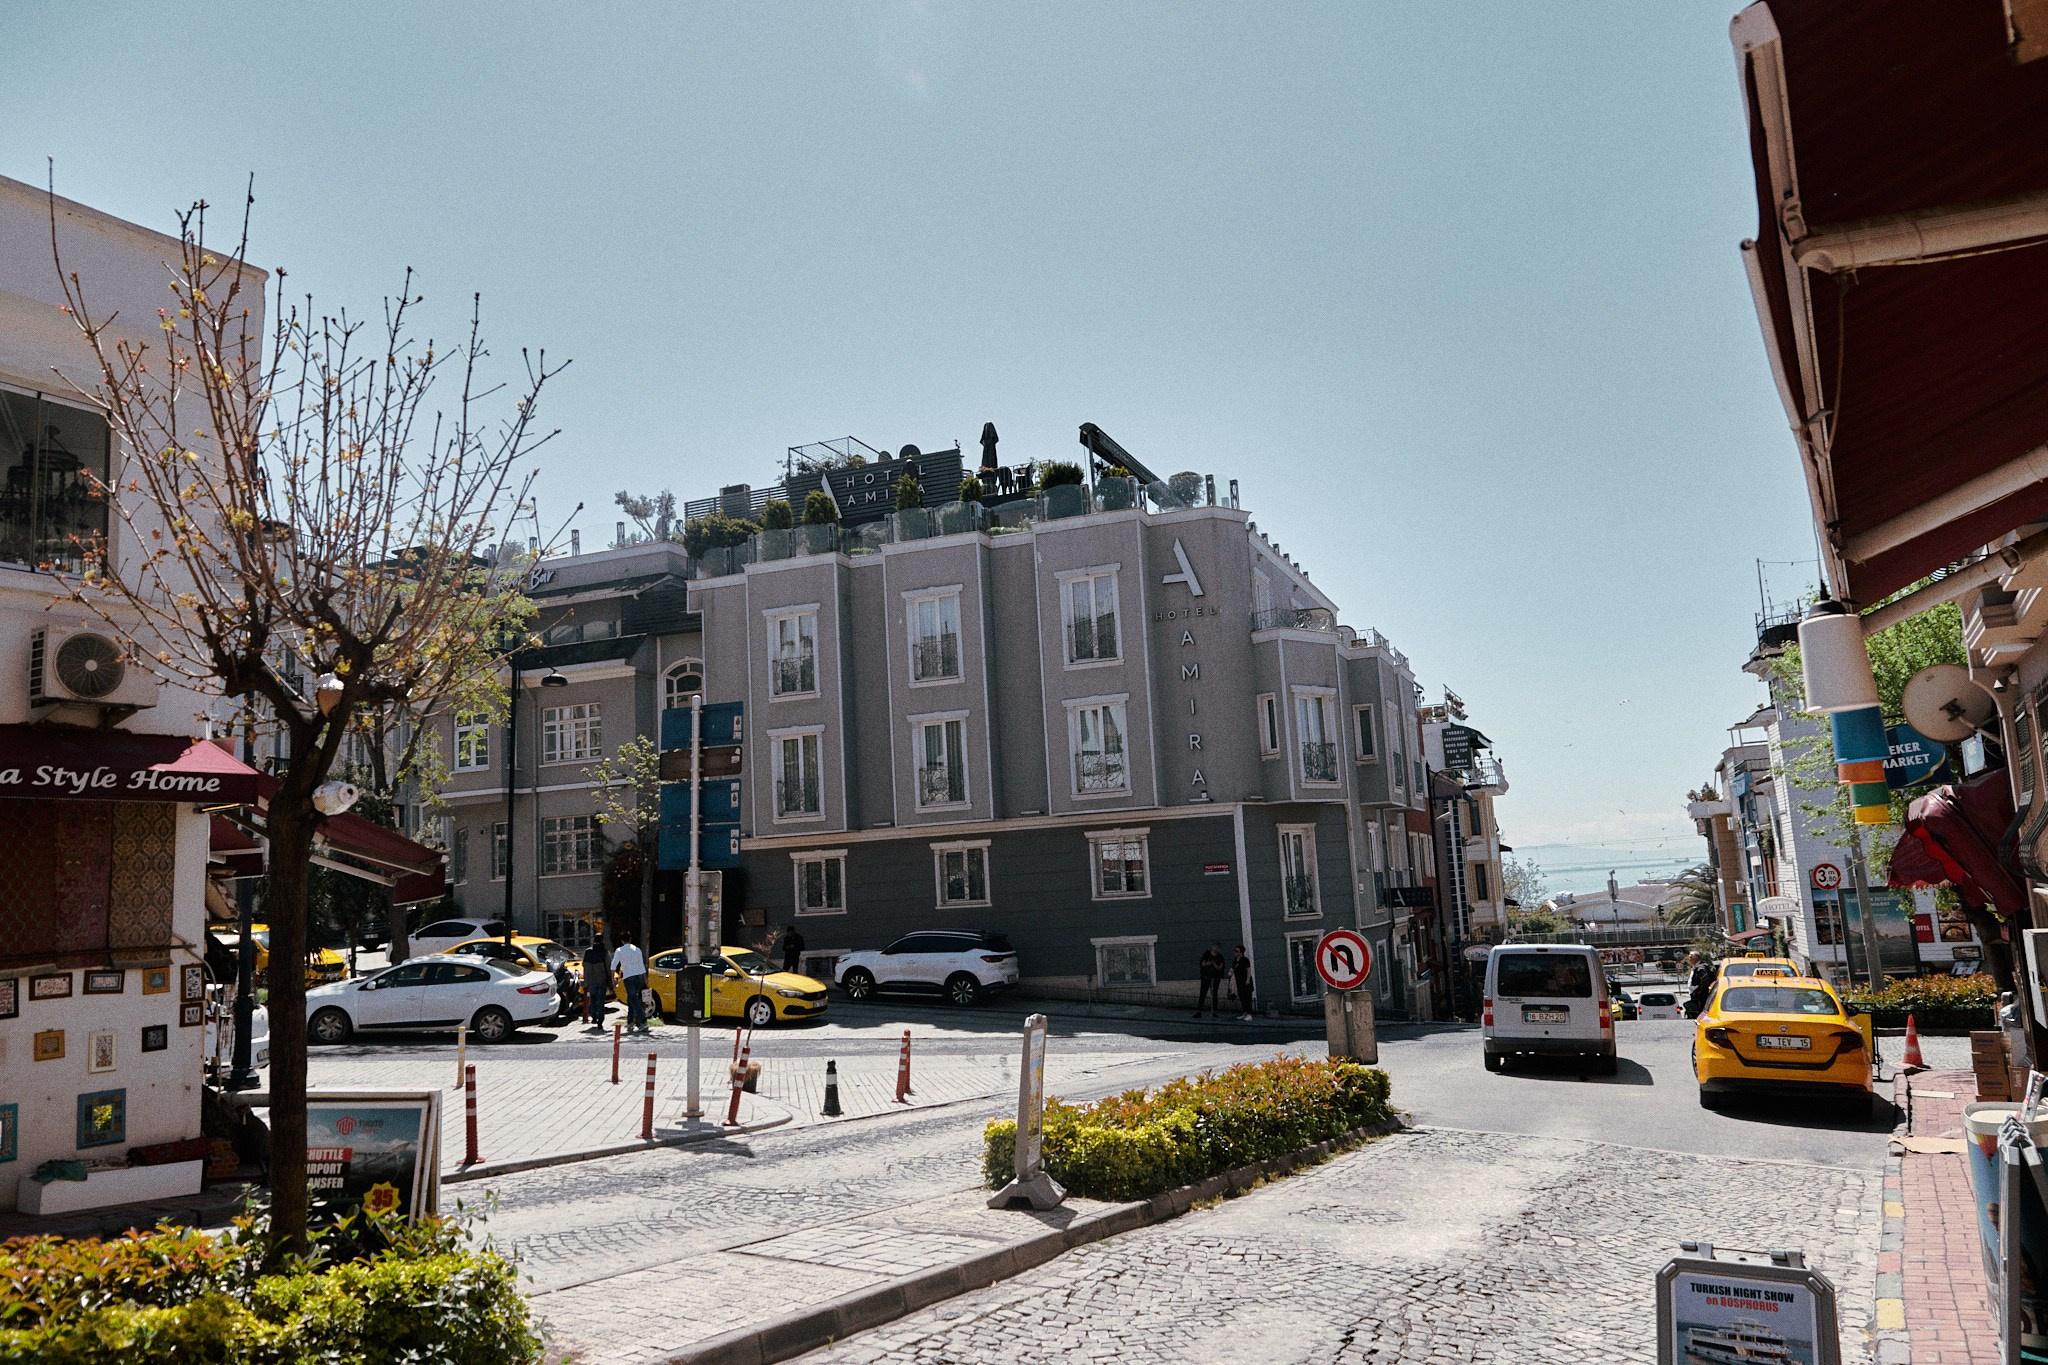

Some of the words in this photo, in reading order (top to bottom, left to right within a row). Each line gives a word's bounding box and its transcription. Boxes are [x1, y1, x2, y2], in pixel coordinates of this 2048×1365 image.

[846, 464, 926, 488] HOTL
[847, 483, 926, 506] AMIA
[528, 567, 554, 590] Bar
[1155, 606, 1217, 621] HOTEL
[1181, 629, 1206, 786] AMIRA
[1888, 741, 1922, 756] EKER
[1881, 753, 1930, 769] MARKET
[31, 765, 118, 795] Style
[126, 769, 221, 793] Home
[1818, 869, 1827, 883] 3
[1765, 902, 1791, 912] HOTEL
[1762, 1037, 1772, 1046] 34
[1777, 1037, 1793, 1047] TEV
[1800, 1038, 1809, 1047] 15
[372, 1188, 394, 1208] 35
[1690, 1282, 1731, 1296] TURKISH
[1733, 1287, 1763, 1299] NIGHT
[1764, 1290, 1794, 1303] SHOW
[1706, 1296, 1719, 1305] on
[1720, 1297, 1779, 1313] BOSPHORUS
